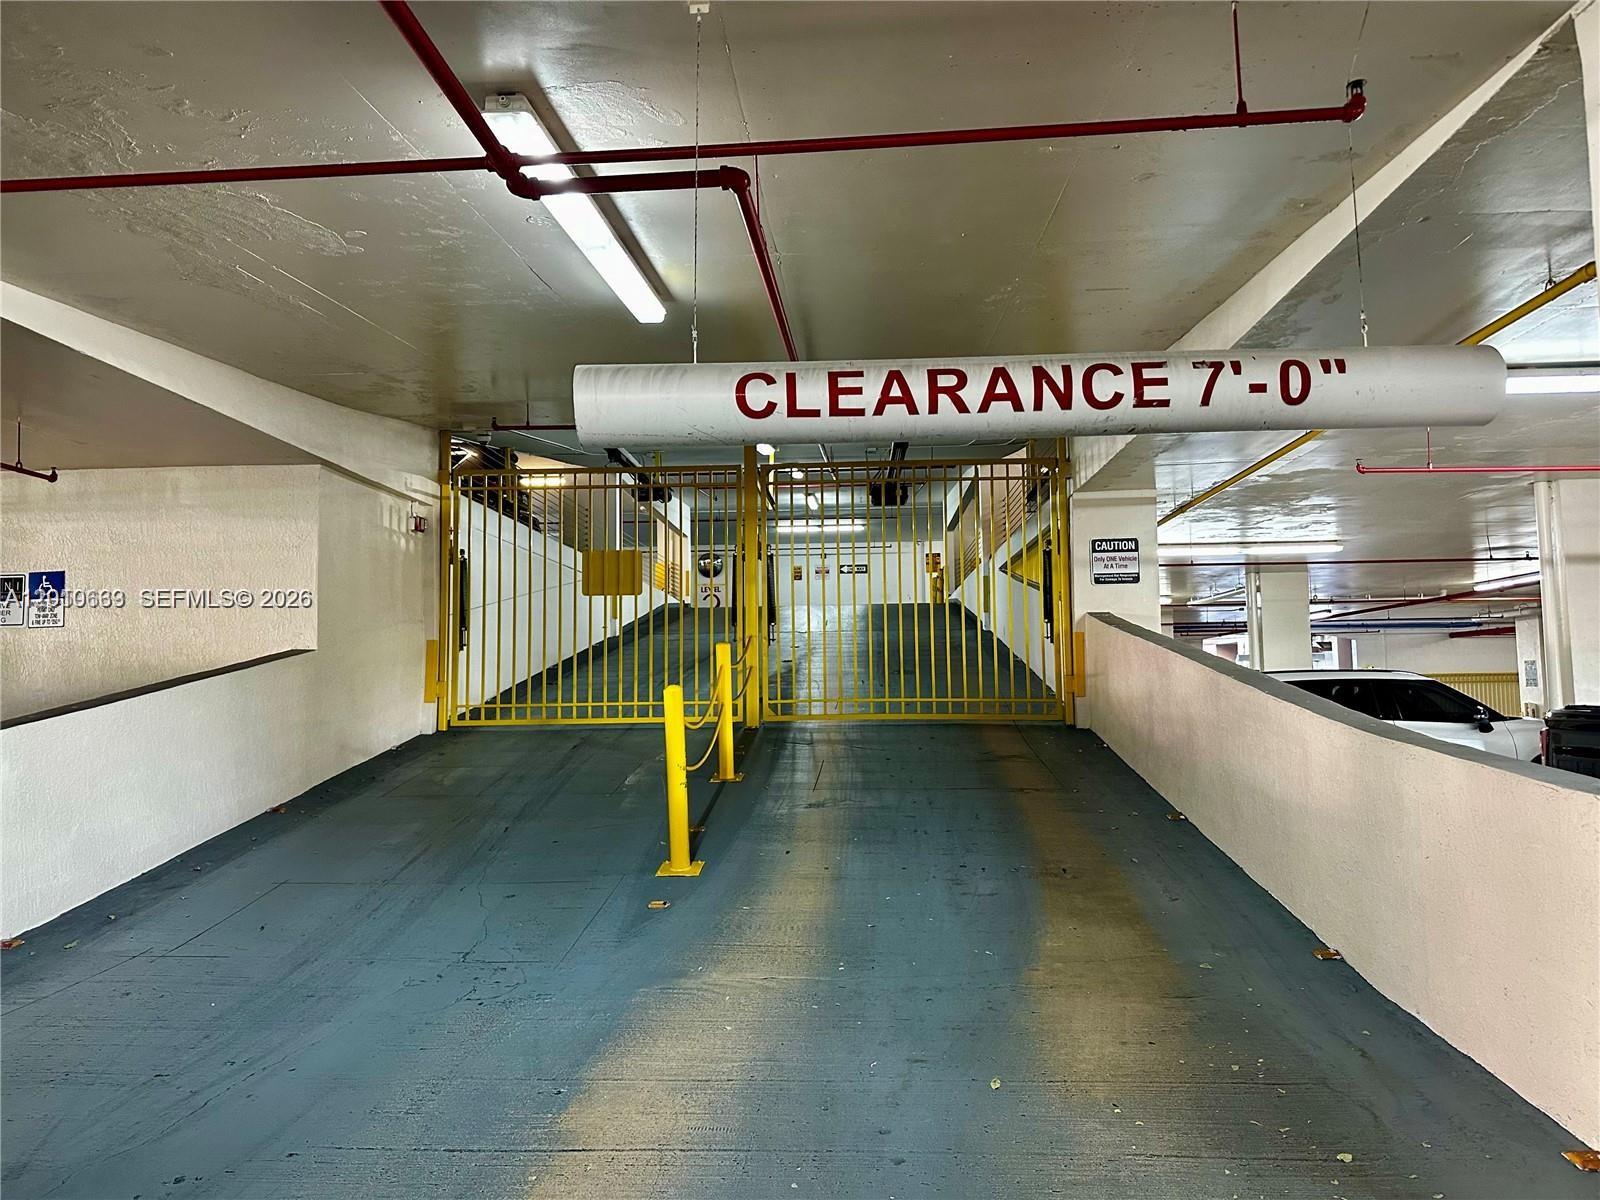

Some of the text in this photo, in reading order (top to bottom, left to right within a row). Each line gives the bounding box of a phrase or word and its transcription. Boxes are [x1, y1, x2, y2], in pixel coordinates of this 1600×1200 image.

[735, 358, 1347, 420] CLEARANCE 7'-0"
[1095, 541, 1135, 550] CAUTION
[1094, 555, 1105, 563] Only
